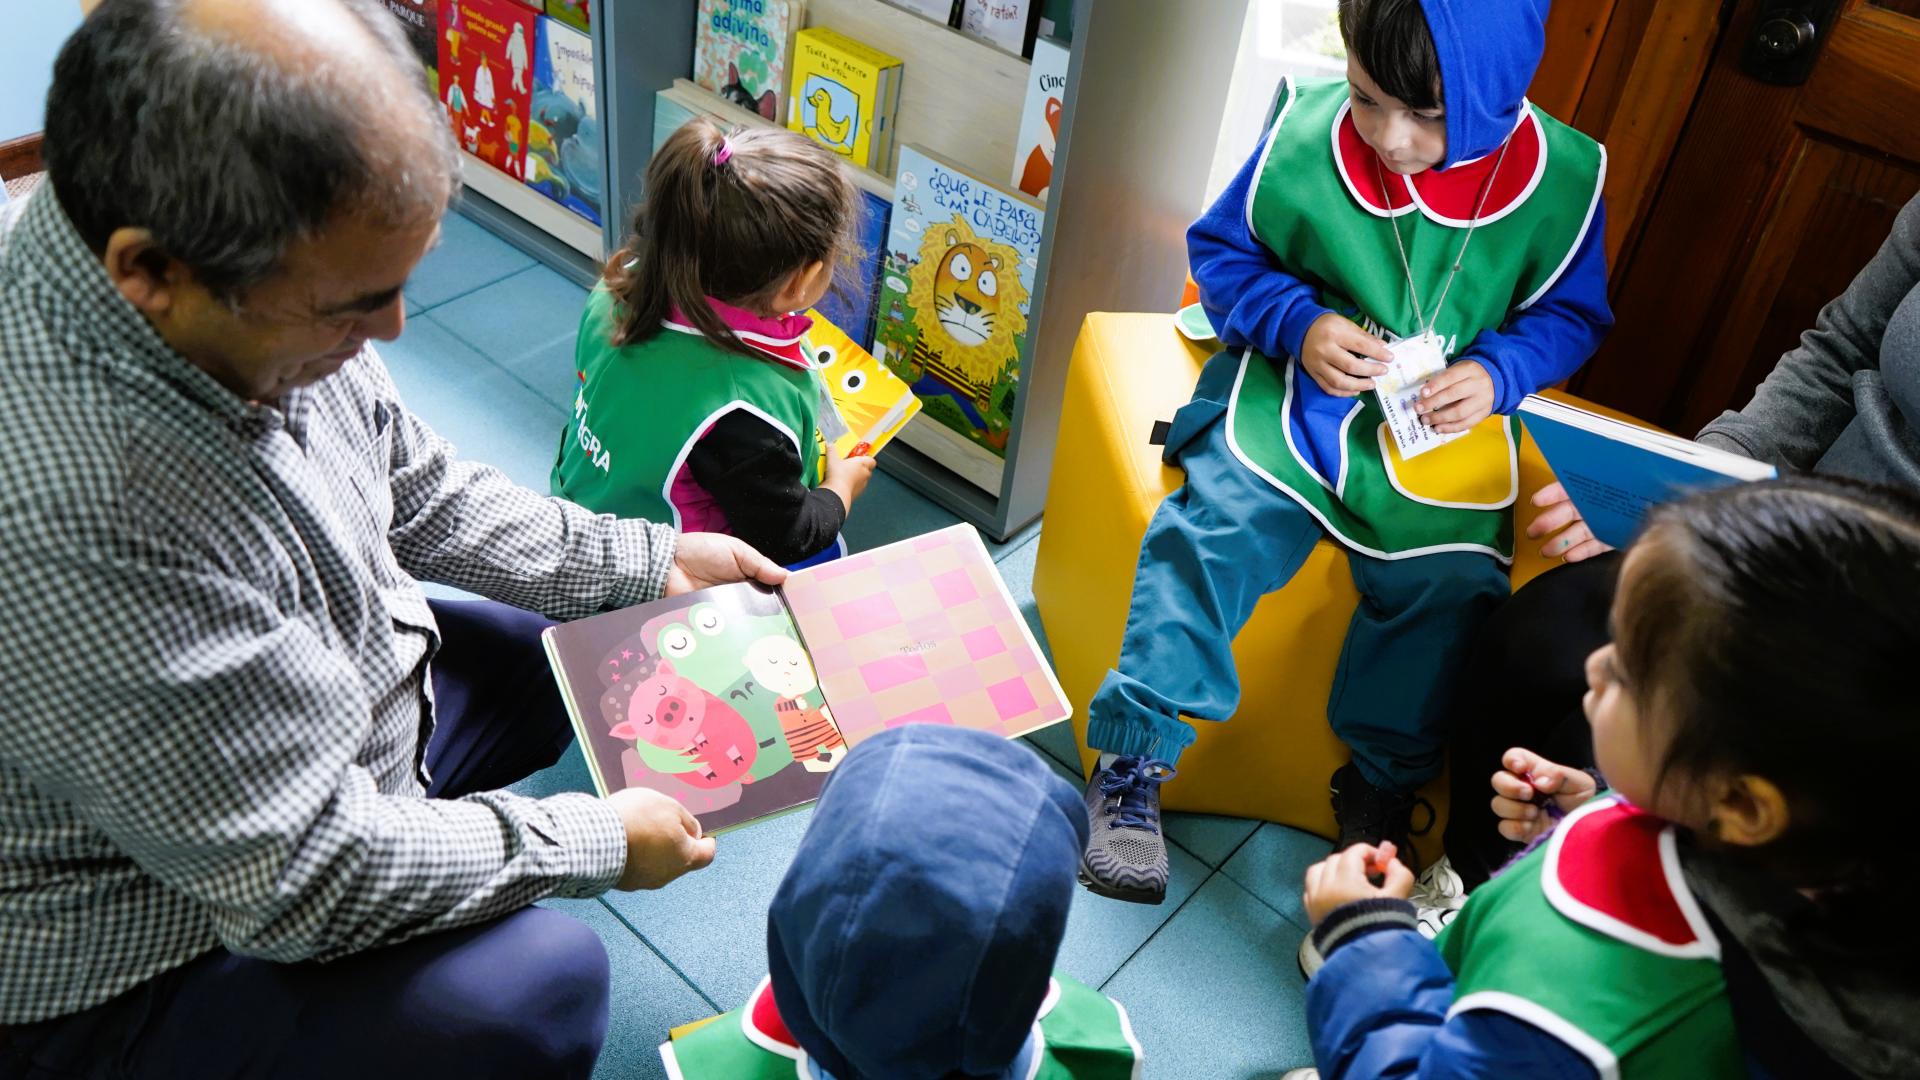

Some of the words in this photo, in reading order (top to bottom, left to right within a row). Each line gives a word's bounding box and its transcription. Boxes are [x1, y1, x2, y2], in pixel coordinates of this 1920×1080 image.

[389, 0, 426, 28] PARQUE
[461, 4, 486, 24] Cuando
[484, 18, 508, 35] grande
[712, 11, 769, 47] adivina
[973, 186, 993, 210] LE
[973, 208, 1041, 253] CABELLO?
[899, 640, 937, 654] Todos
